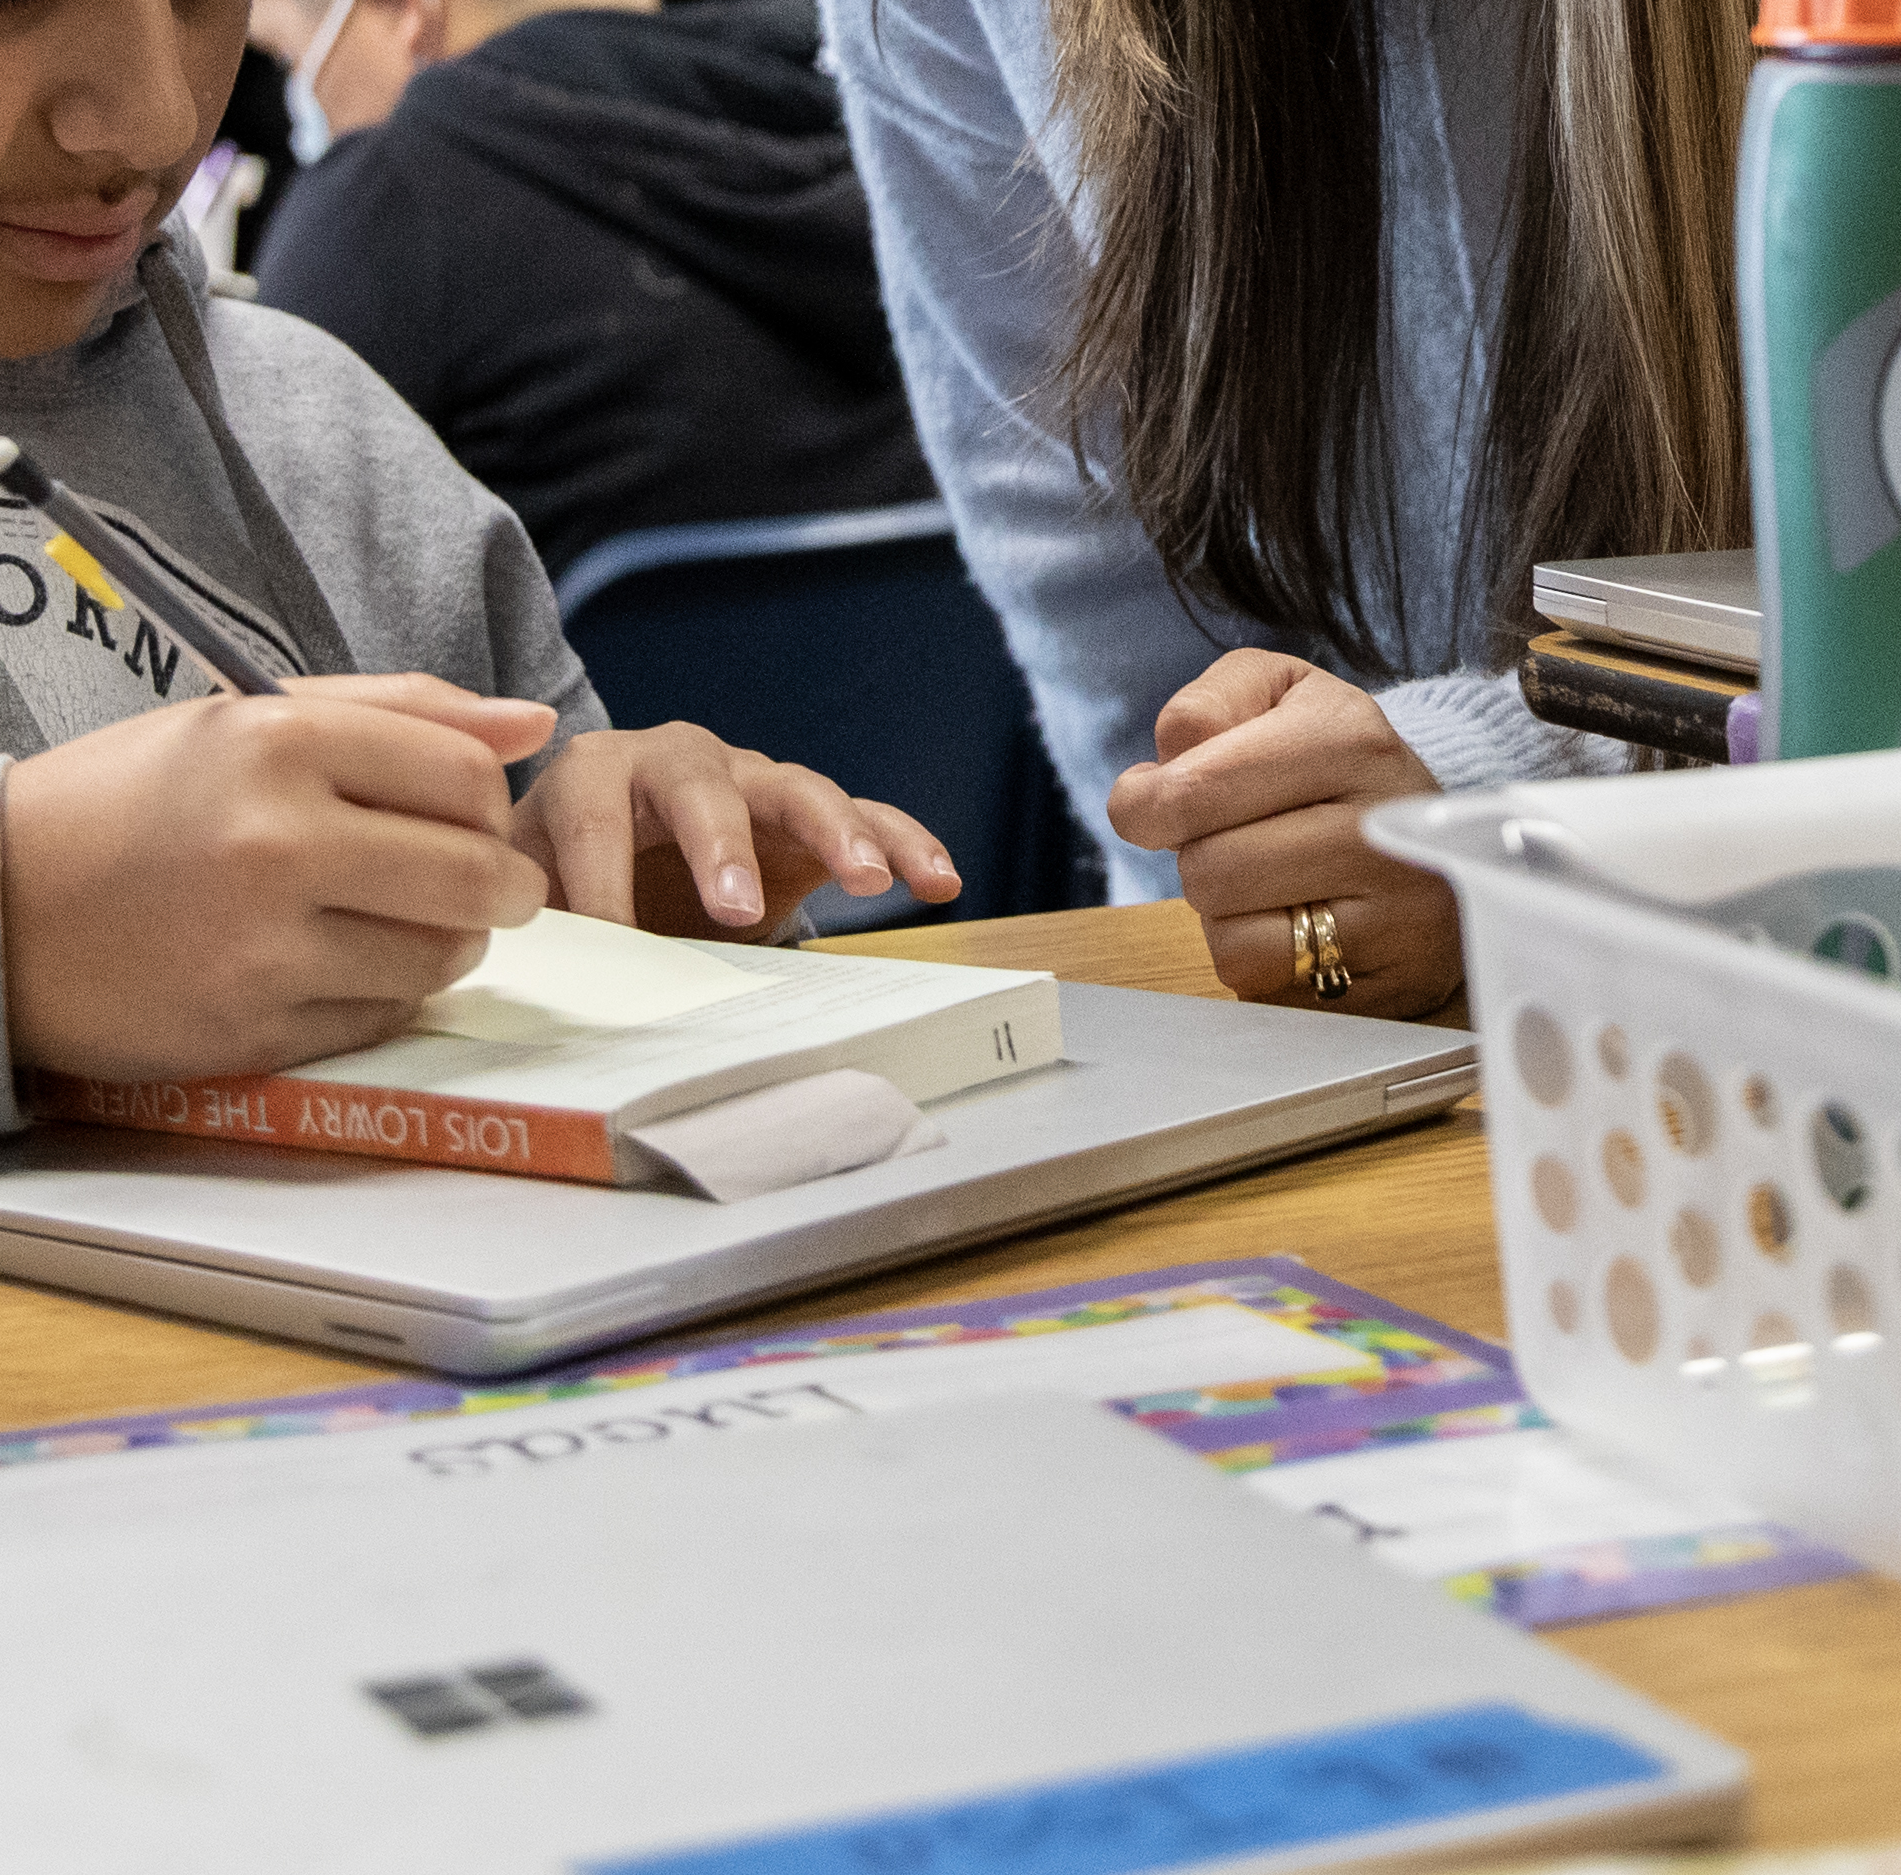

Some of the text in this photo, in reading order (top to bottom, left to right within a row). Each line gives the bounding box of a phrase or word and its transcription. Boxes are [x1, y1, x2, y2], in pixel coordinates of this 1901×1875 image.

[86, 1080, 531, 1160] LOIS LOWRY THE GIVER
